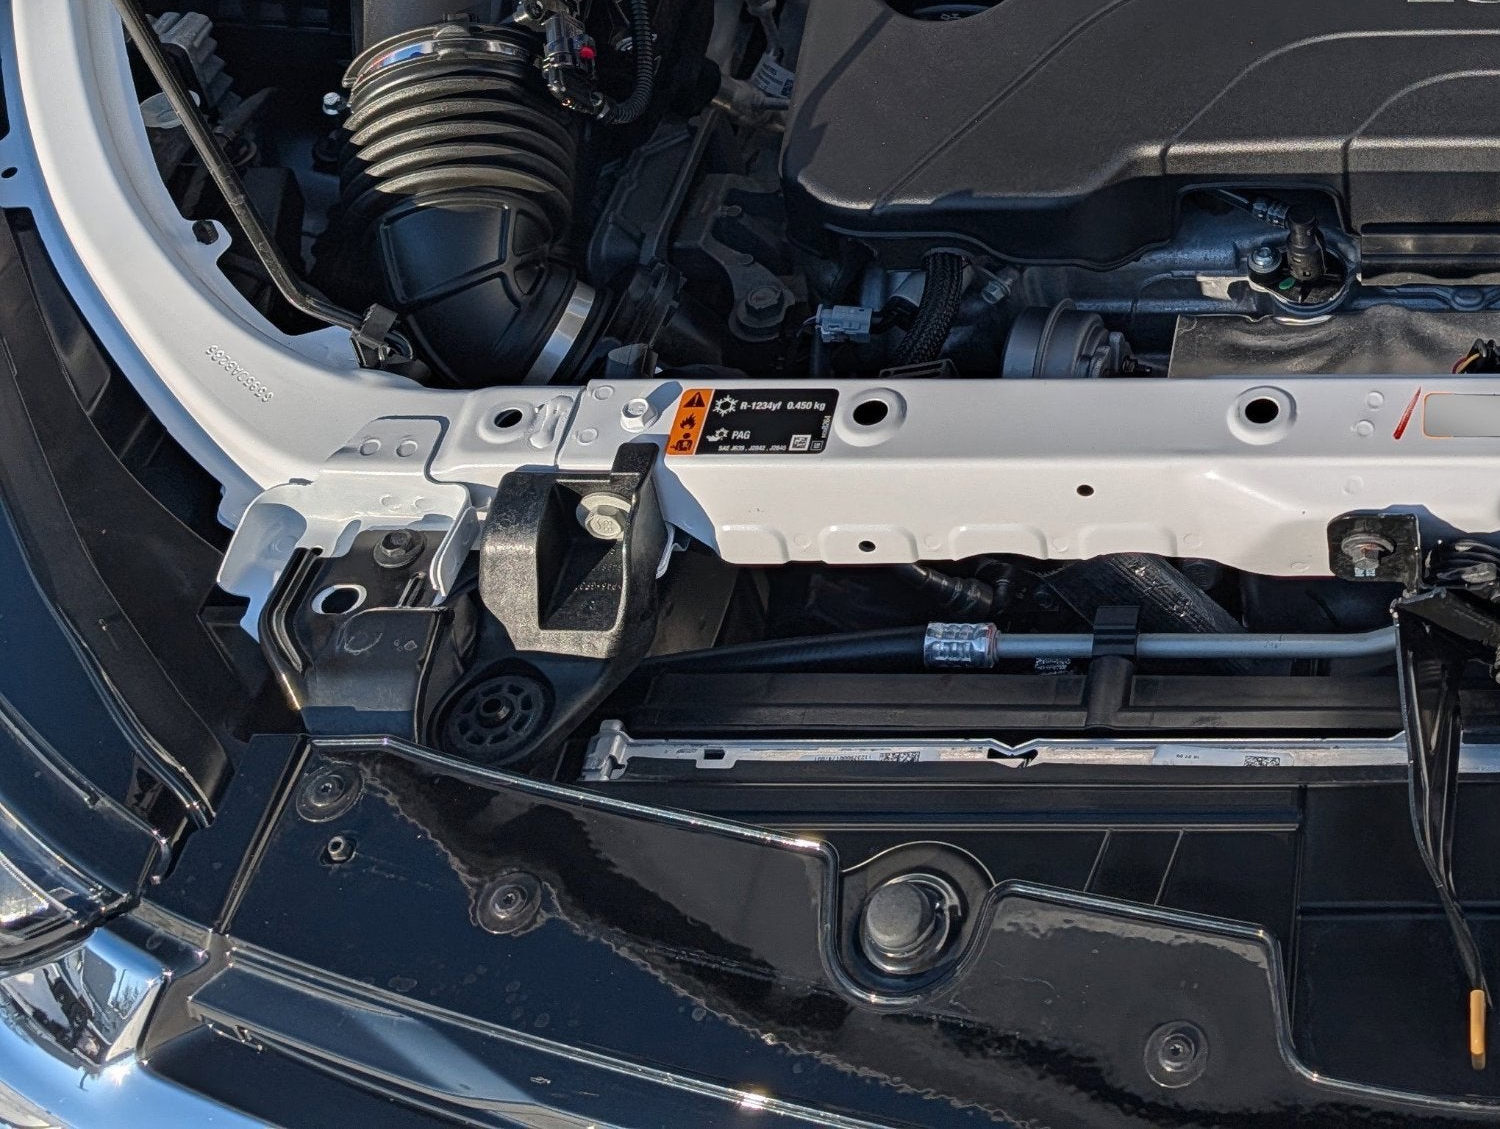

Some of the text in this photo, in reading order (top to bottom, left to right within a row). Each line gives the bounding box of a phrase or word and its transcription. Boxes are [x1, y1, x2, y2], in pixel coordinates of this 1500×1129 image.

[740, 401, 826, 412] R-1234yf 0.450 kg
[731, 430, 751, 440] PAG
